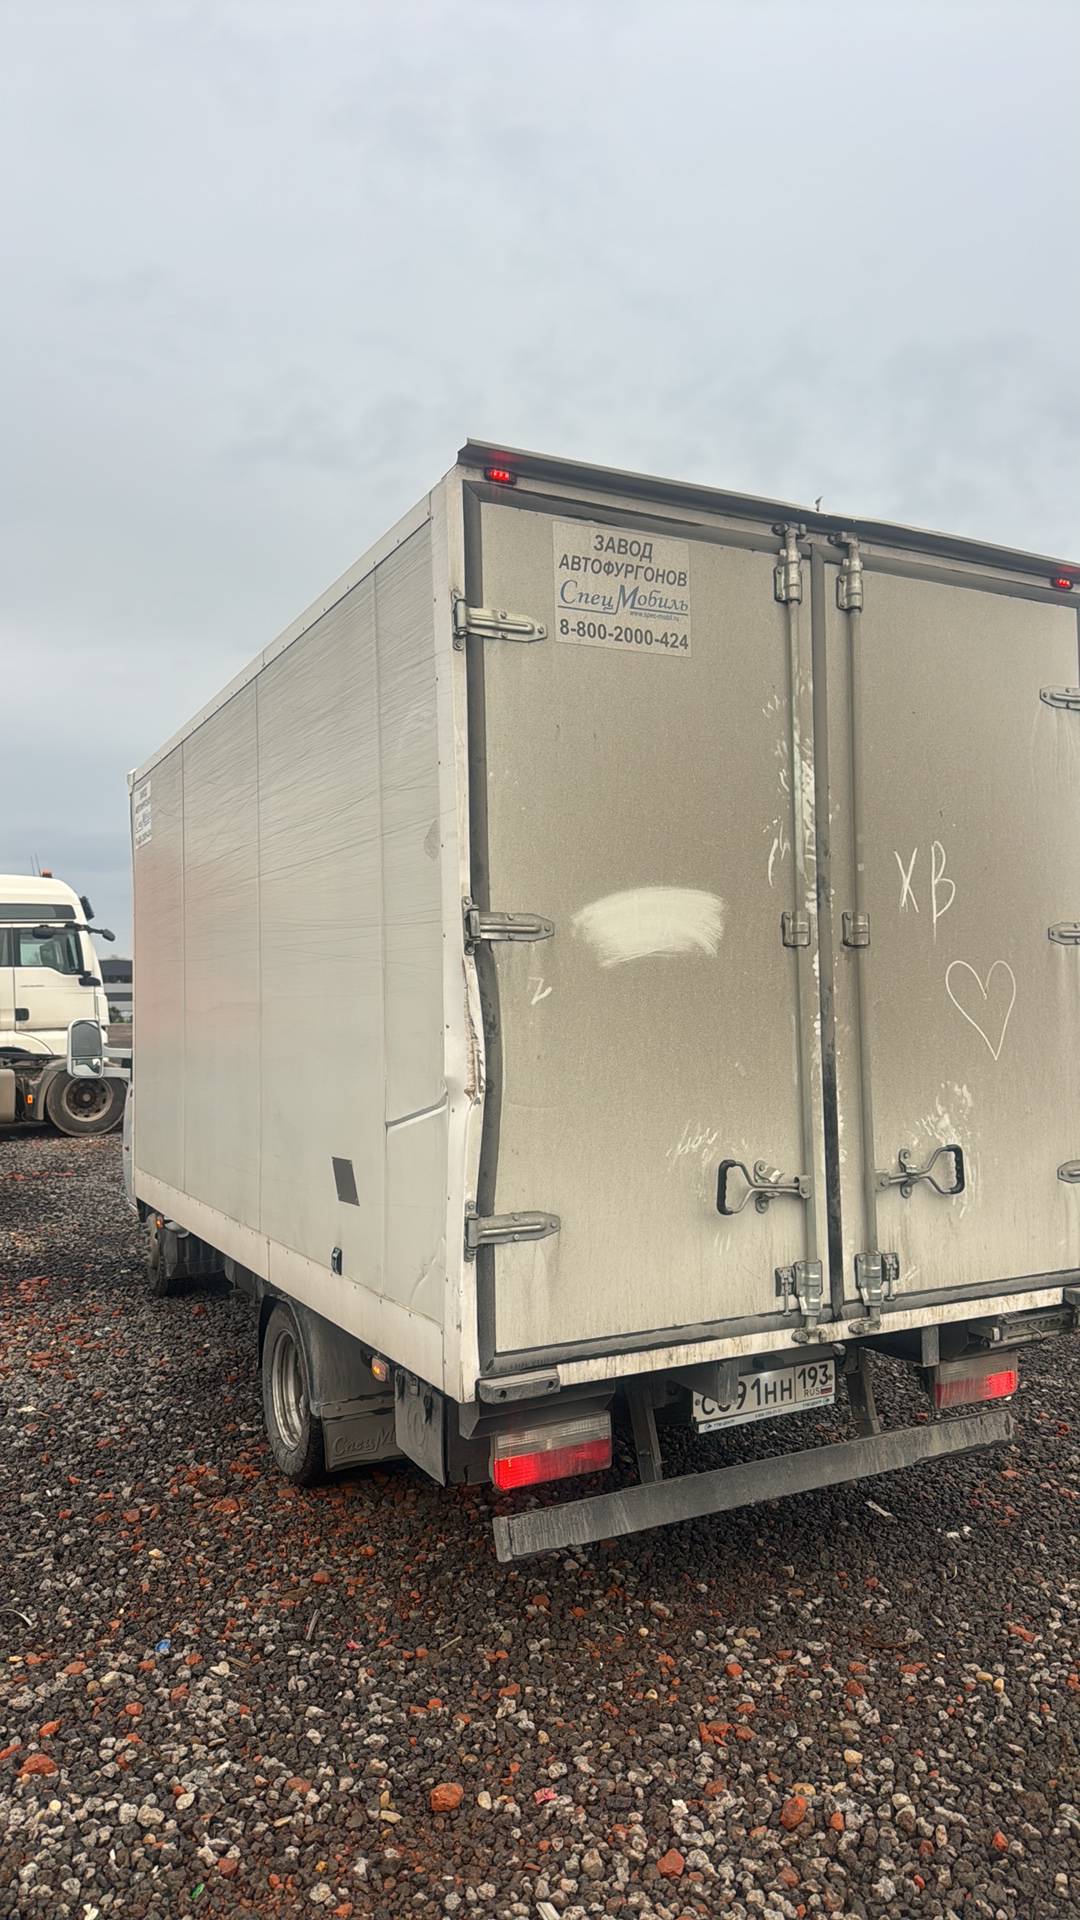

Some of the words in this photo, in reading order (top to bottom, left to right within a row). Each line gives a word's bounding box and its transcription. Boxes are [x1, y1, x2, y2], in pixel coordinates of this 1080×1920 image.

[593, 534, 653, 563] ЗАВОД
[559, 554, 687, 587] АВТОФУРГОНОВ
[559, 618, 688, 650] 8-800-2000-424
[702, 1377, 792, 1415] С91НН
[797, 1364, 829, 1389] 193
[803, 1388, 821, 1398] RUS
